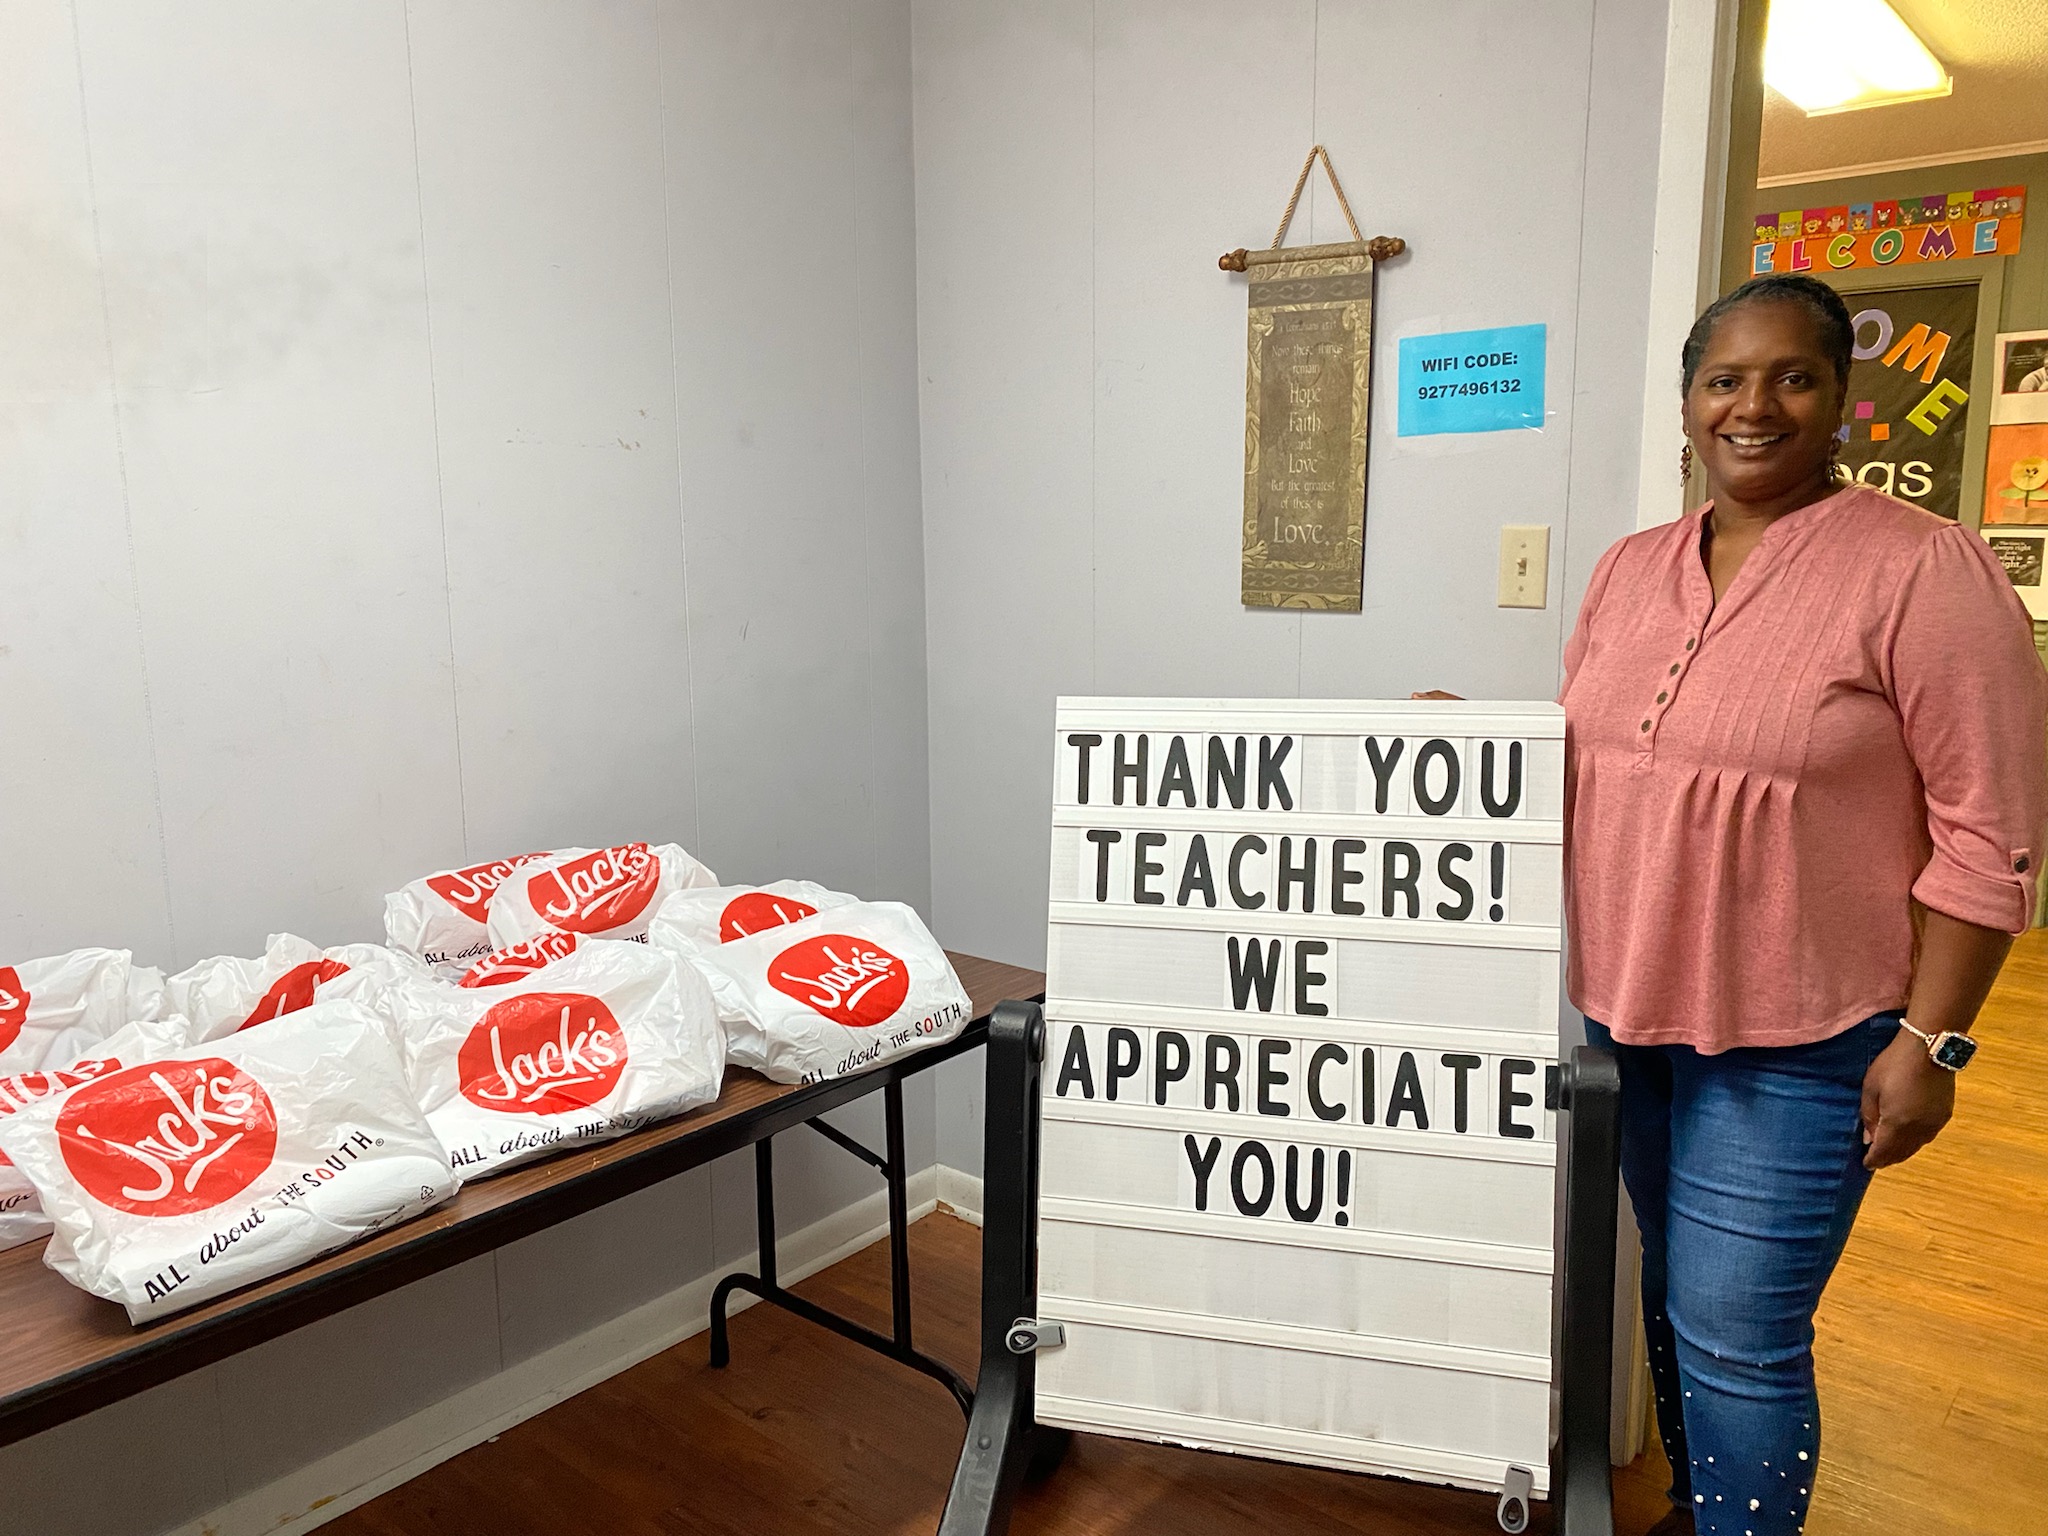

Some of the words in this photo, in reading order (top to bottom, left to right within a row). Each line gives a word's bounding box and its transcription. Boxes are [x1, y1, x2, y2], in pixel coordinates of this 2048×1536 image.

[1290, 381, 1321, 407] Hope
[1418, 378, 1521, 400] 9277496132
[1421, 357, 1458, 373] WIFI
[1464, 352, 1518, 368] CODE:
[1289, 411, 1320, 432] Faith
[1289, 453, 1318, 473] Love
[1273, 516, 1330, 546] Love.
[1067, 734, 1293, 811] THANK
[1365, 736, 1523, 818] YOU
[546, 844, 650, 918] Jack's
[1086, 829, 1505, 922] TEACHERS!
[424, 951, 450, 967] ALL
[457, 942, 495, 959] abou
[781, 945, 893, 1009] Jack's
[1227, 936, 1329, 1016] WE
[477, 1006, 618, 1101] Jack's
[837, 1038, 882, 1075] about
[889, 1029, 911, 1049] THE
[1056, 1025, 1536, 1138] APPRECIATE
[76, 1067, 254, 1202] Jack's
[450, 1144, 487, 1169] ALL
[574, 1120, 604, 1139] THE
[1184, 1134, 1351, 1226] YOU!
[142, 1264, 190, 1303] ALL
[199, 1207, 266, 1265] about
[272, 1182, 306, 1207] THE
